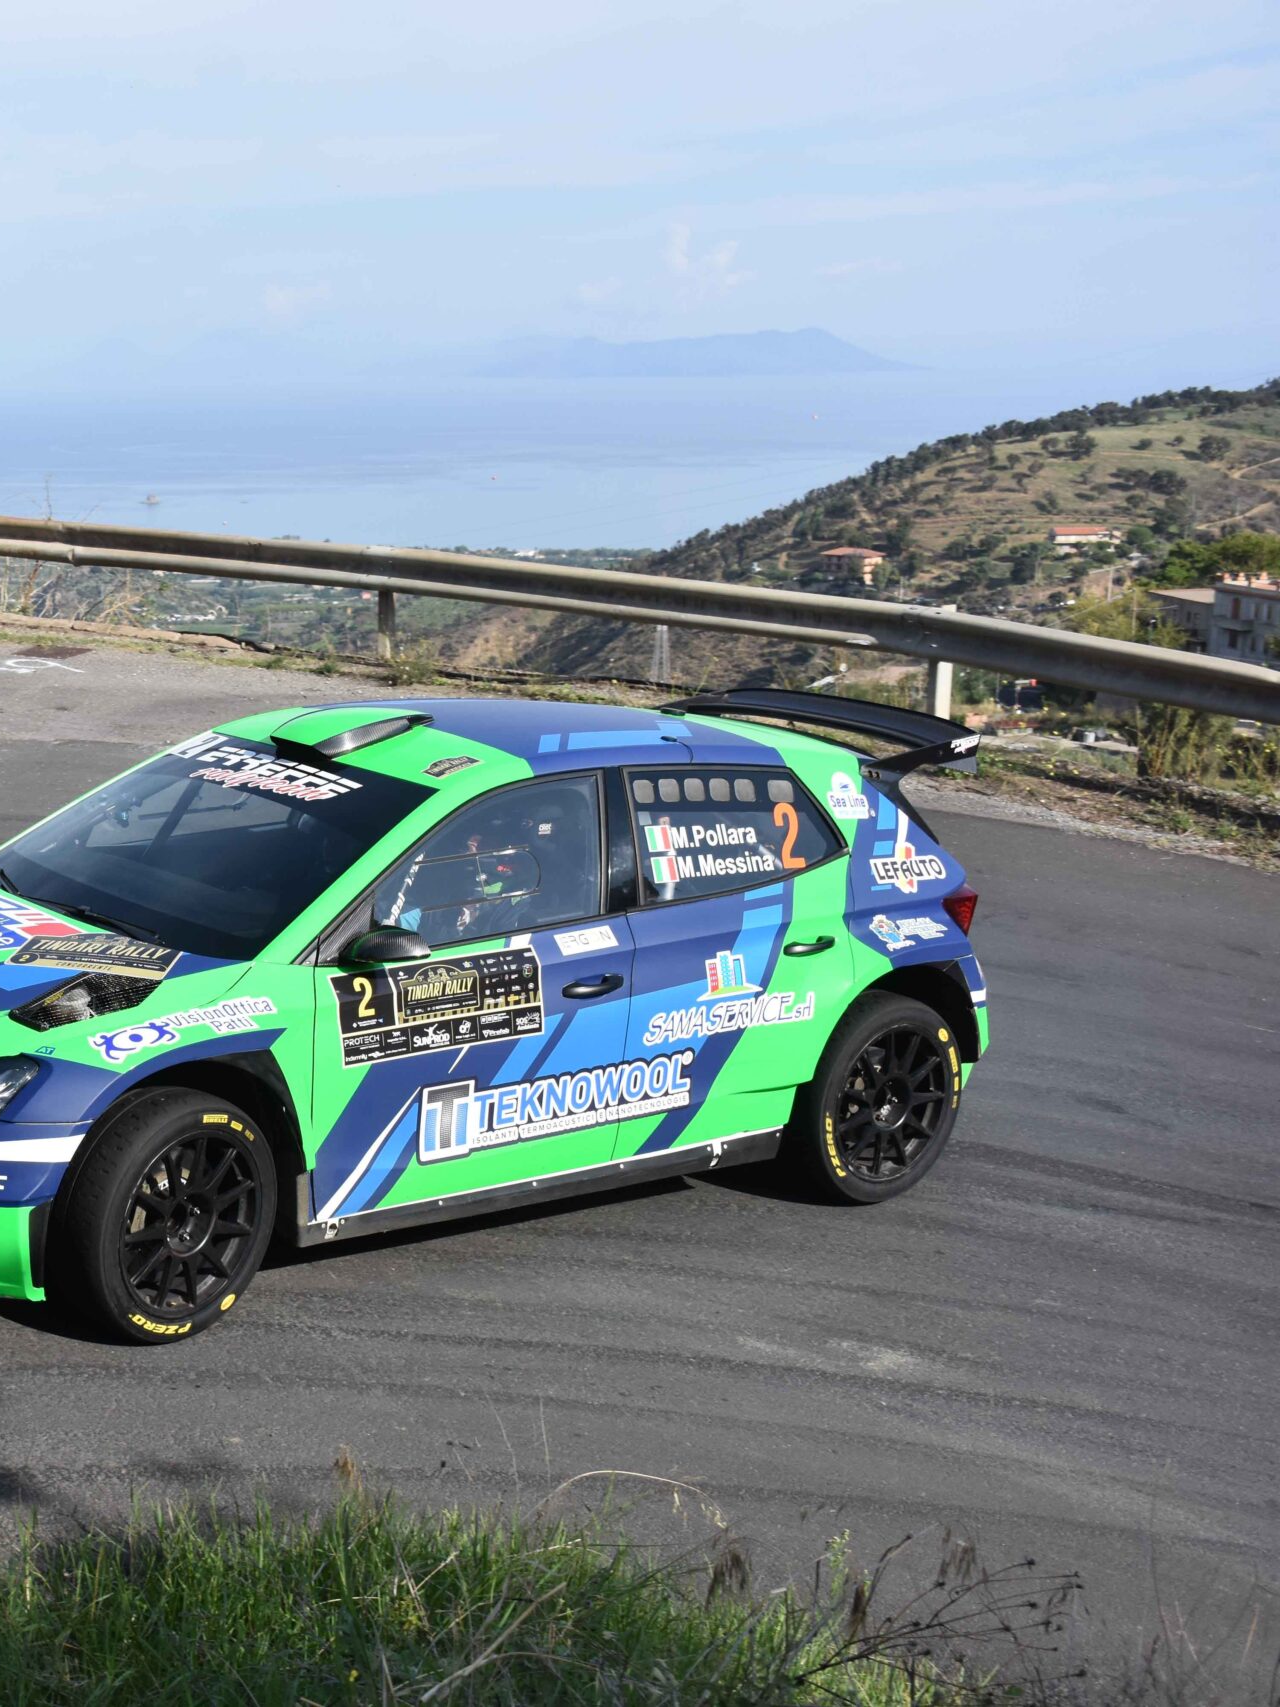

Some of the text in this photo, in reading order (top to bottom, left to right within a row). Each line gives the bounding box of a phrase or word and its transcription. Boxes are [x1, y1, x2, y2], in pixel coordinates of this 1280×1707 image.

[830, 795, 866, 808] Sea Line
[671, 823, 758, 849] M.Pollara
[772, 802, 807, 869] 2
[677, 851, 775, 879] M.Messina
[873, 858, 943, 881] LEFAUTO
[30, 939, 171, 959] TINDARI RALLY
[559, 929, 612, 946] ERGN
[18, 954, 31, 962] 2
[352, 976, 376, 1018] 2
[407, 977, 474, 1001] TINDARI RALLY
[209, 1016, 254, 1032] Patti
[344, 1034, 380, 1048] PROTECH
[472, 1094, 688, 1145] ISOLANTI TERMOACUSTICI E NANOTECNOLOGIE
